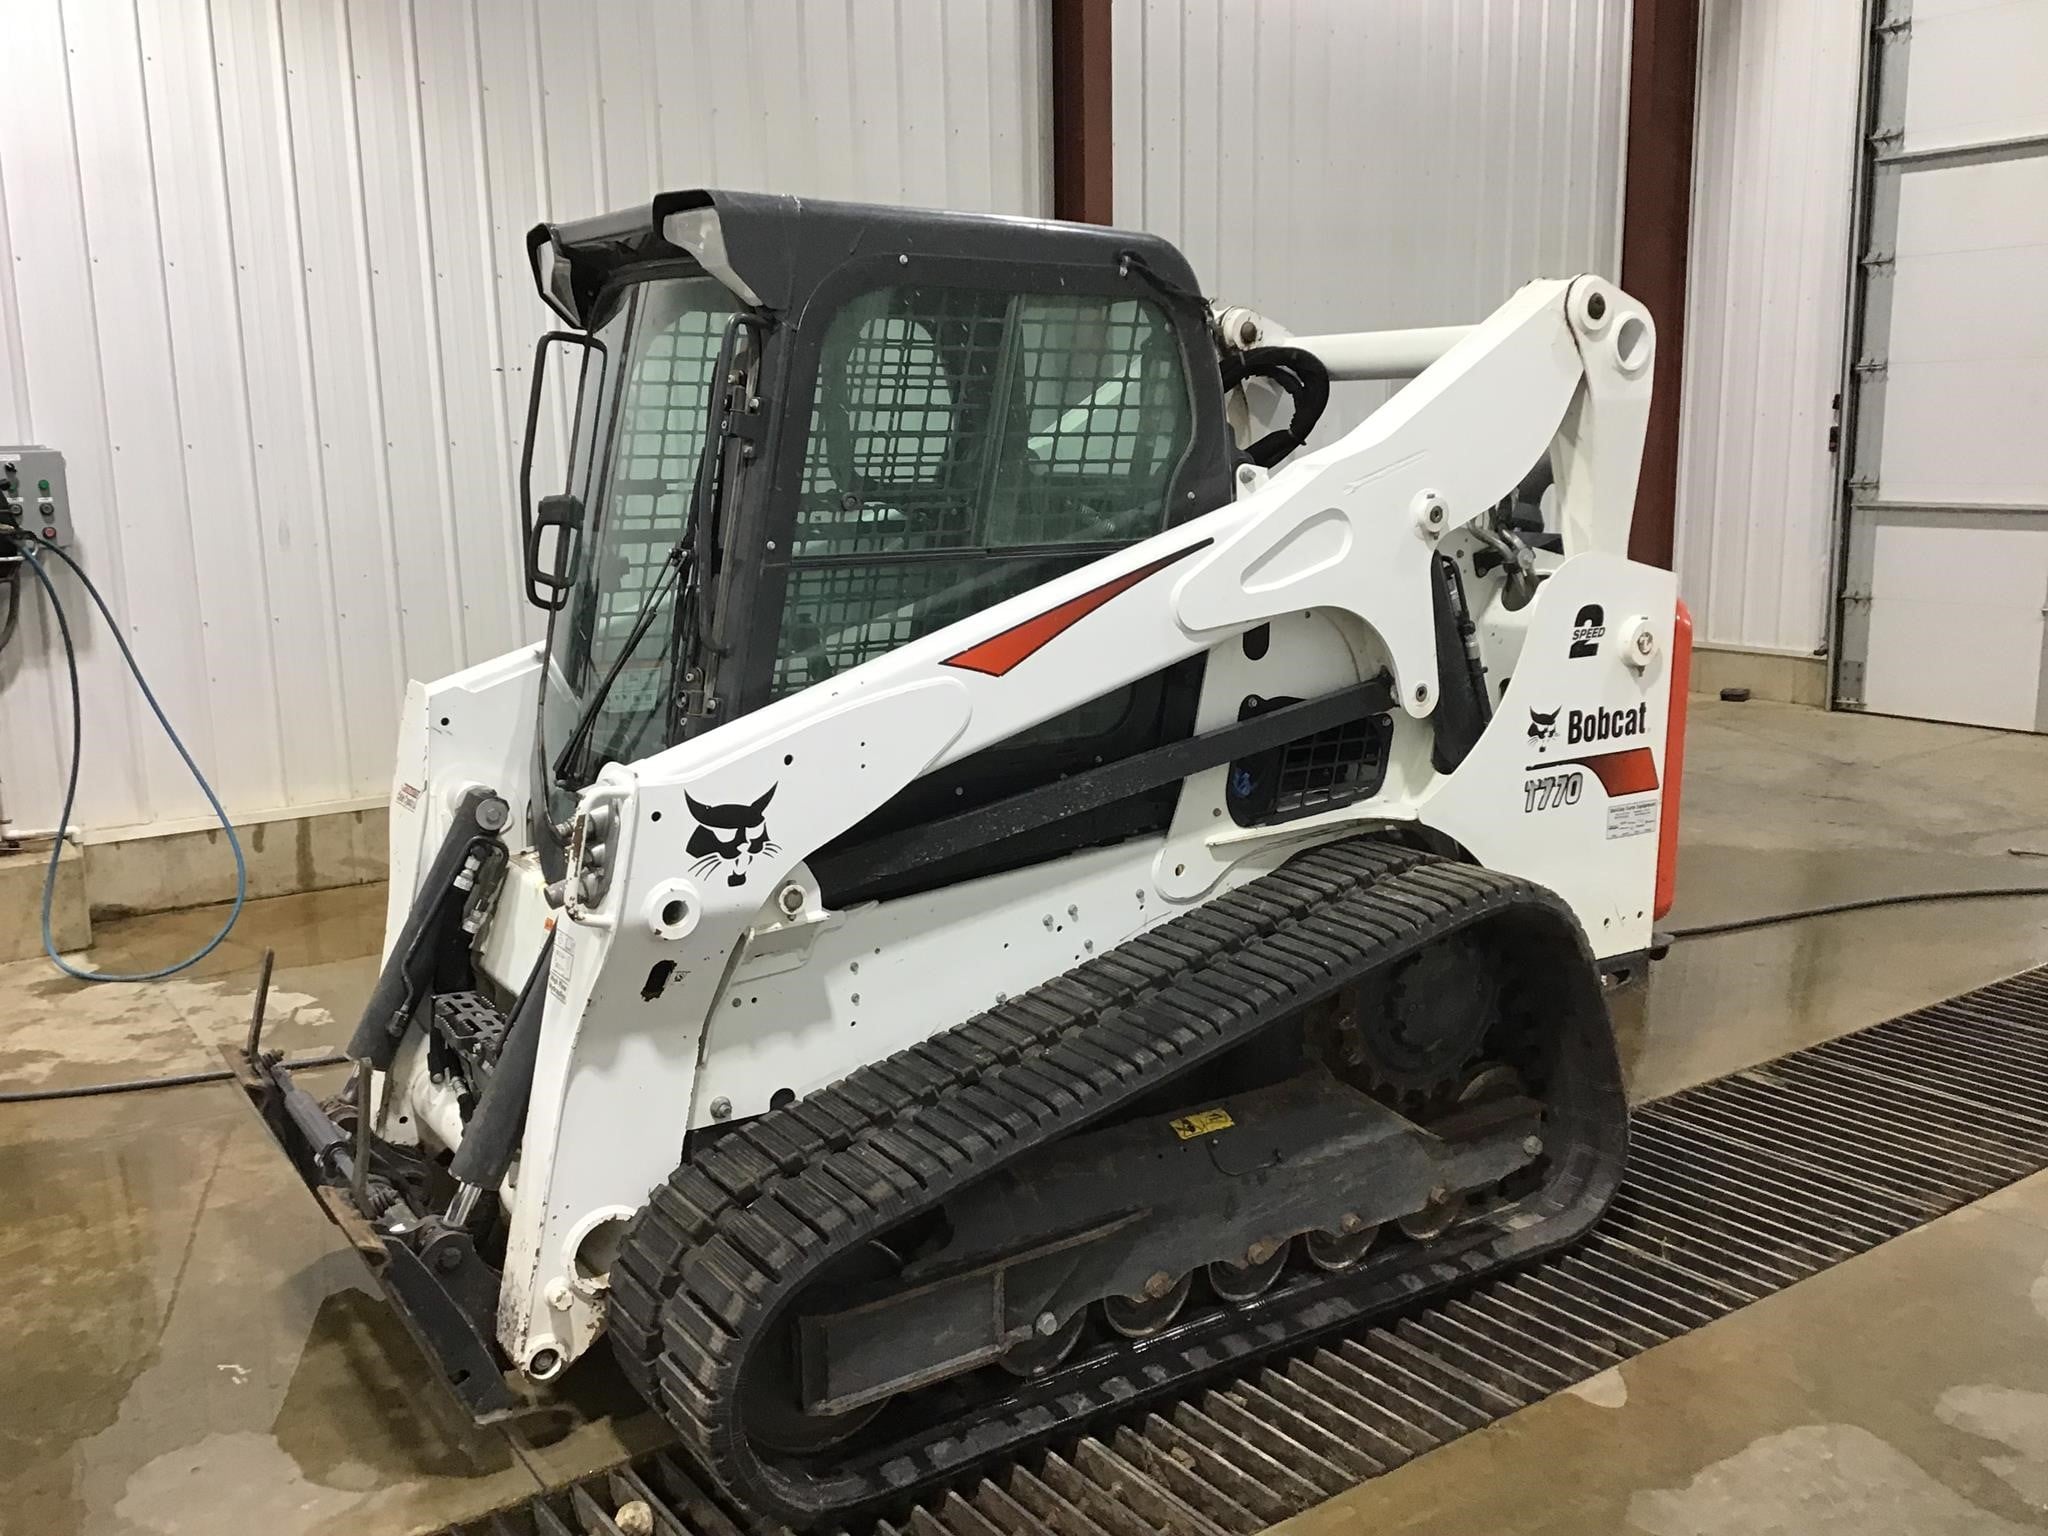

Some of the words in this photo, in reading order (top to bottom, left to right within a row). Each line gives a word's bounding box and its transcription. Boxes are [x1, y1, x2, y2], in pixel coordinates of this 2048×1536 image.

[1568, 603, 1605, 659] 2
[1572, 626, 1606, 641] SPEED
[1567, 701, 1647, 745] Bobcat
[1524, 771, 1584, 813] T770
